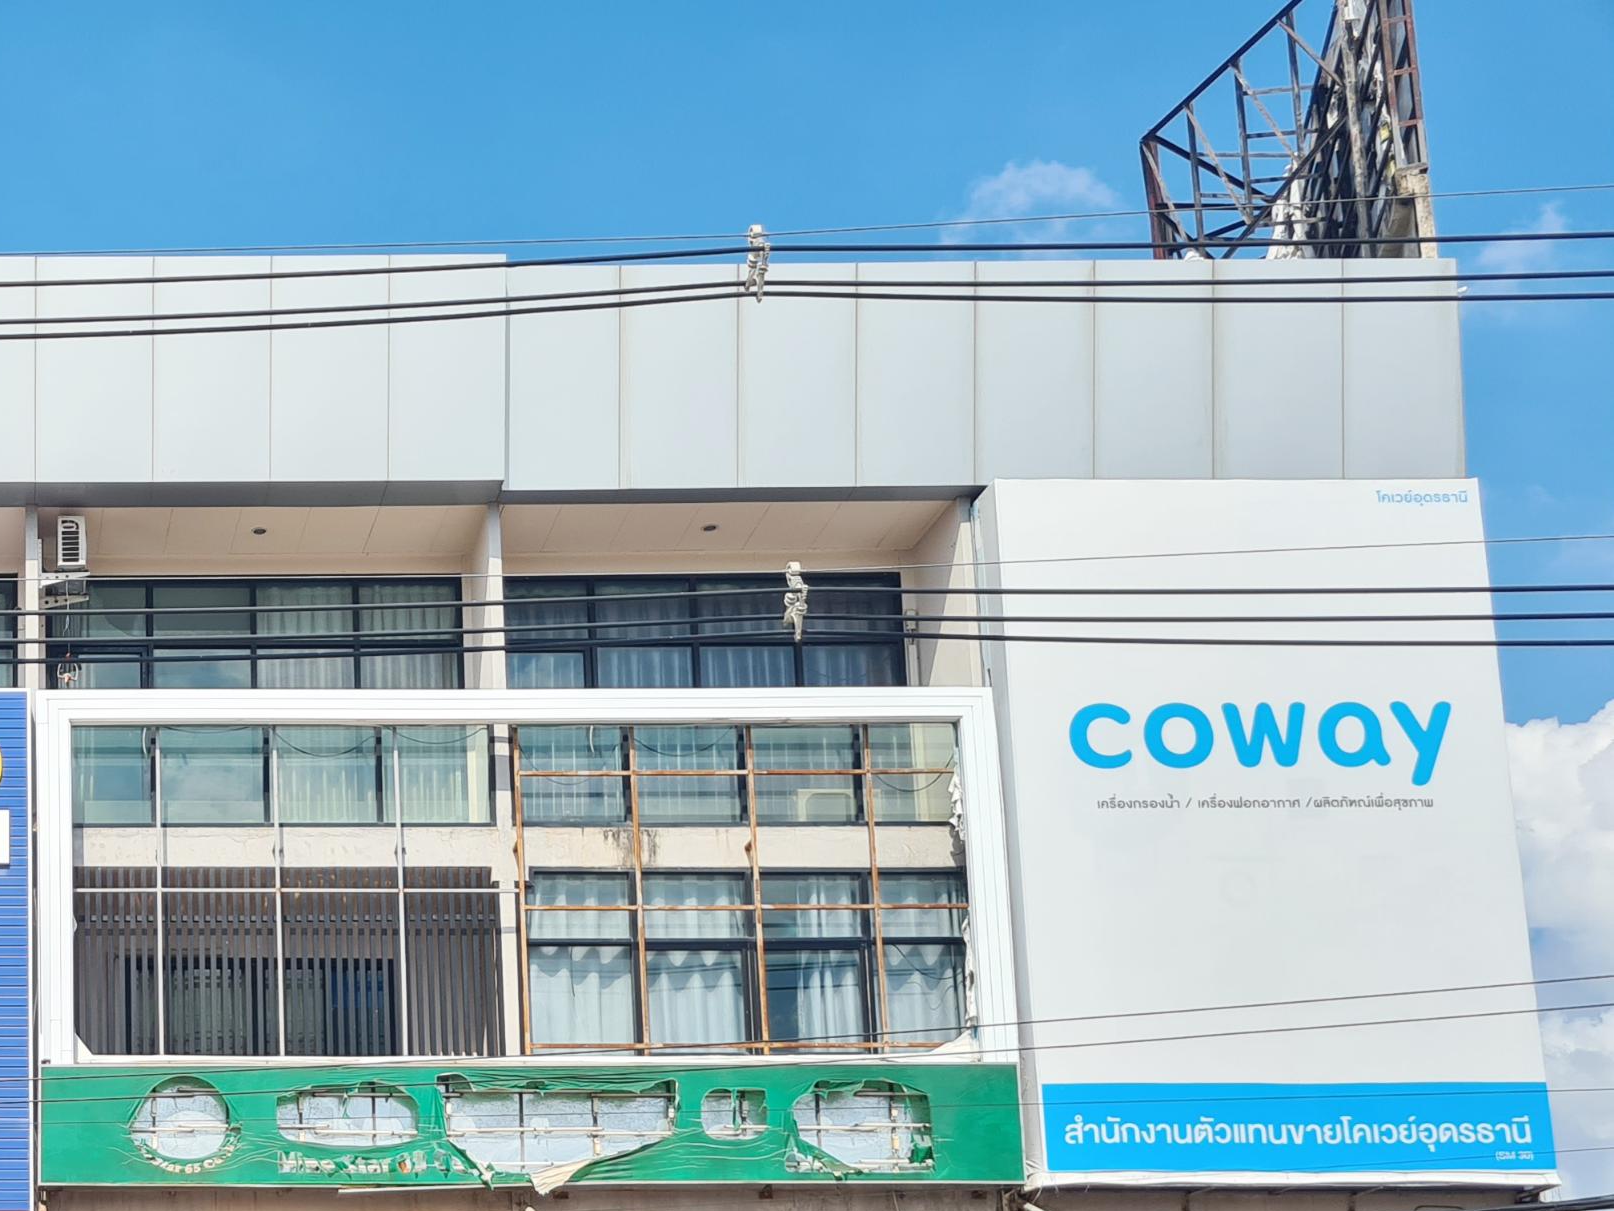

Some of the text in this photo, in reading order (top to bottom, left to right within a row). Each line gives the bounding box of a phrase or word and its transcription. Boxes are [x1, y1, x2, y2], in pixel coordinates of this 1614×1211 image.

[1065, 1114, 1532, 1152] สำนักงานตัวแทนขายโคเวย์อุดรธานี
